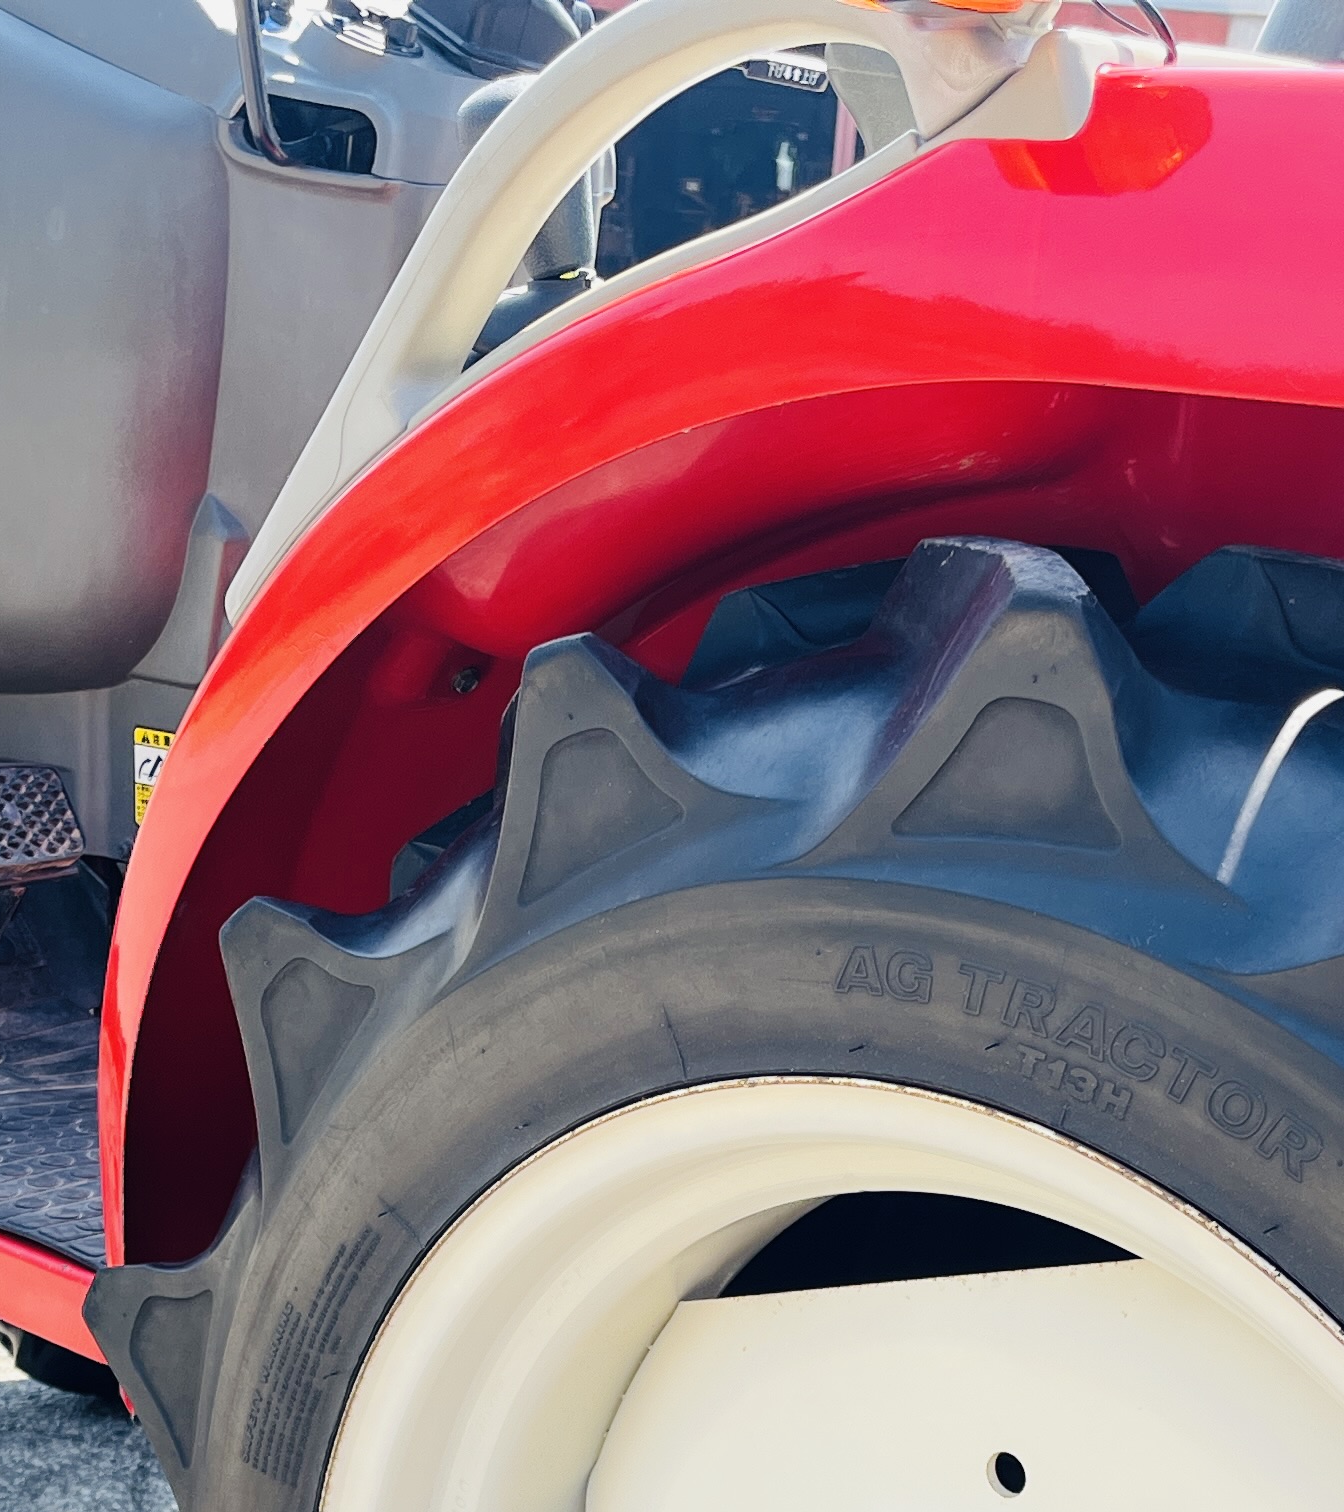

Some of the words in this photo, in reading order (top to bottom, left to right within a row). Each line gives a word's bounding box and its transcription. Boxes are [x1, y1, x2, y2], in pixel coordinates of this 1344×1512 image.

[834, 945, 934, 1004] AG
[959, 962, 1324, 1183] TRACTOR
[1016, 1044, 1133, 1120] T13H
